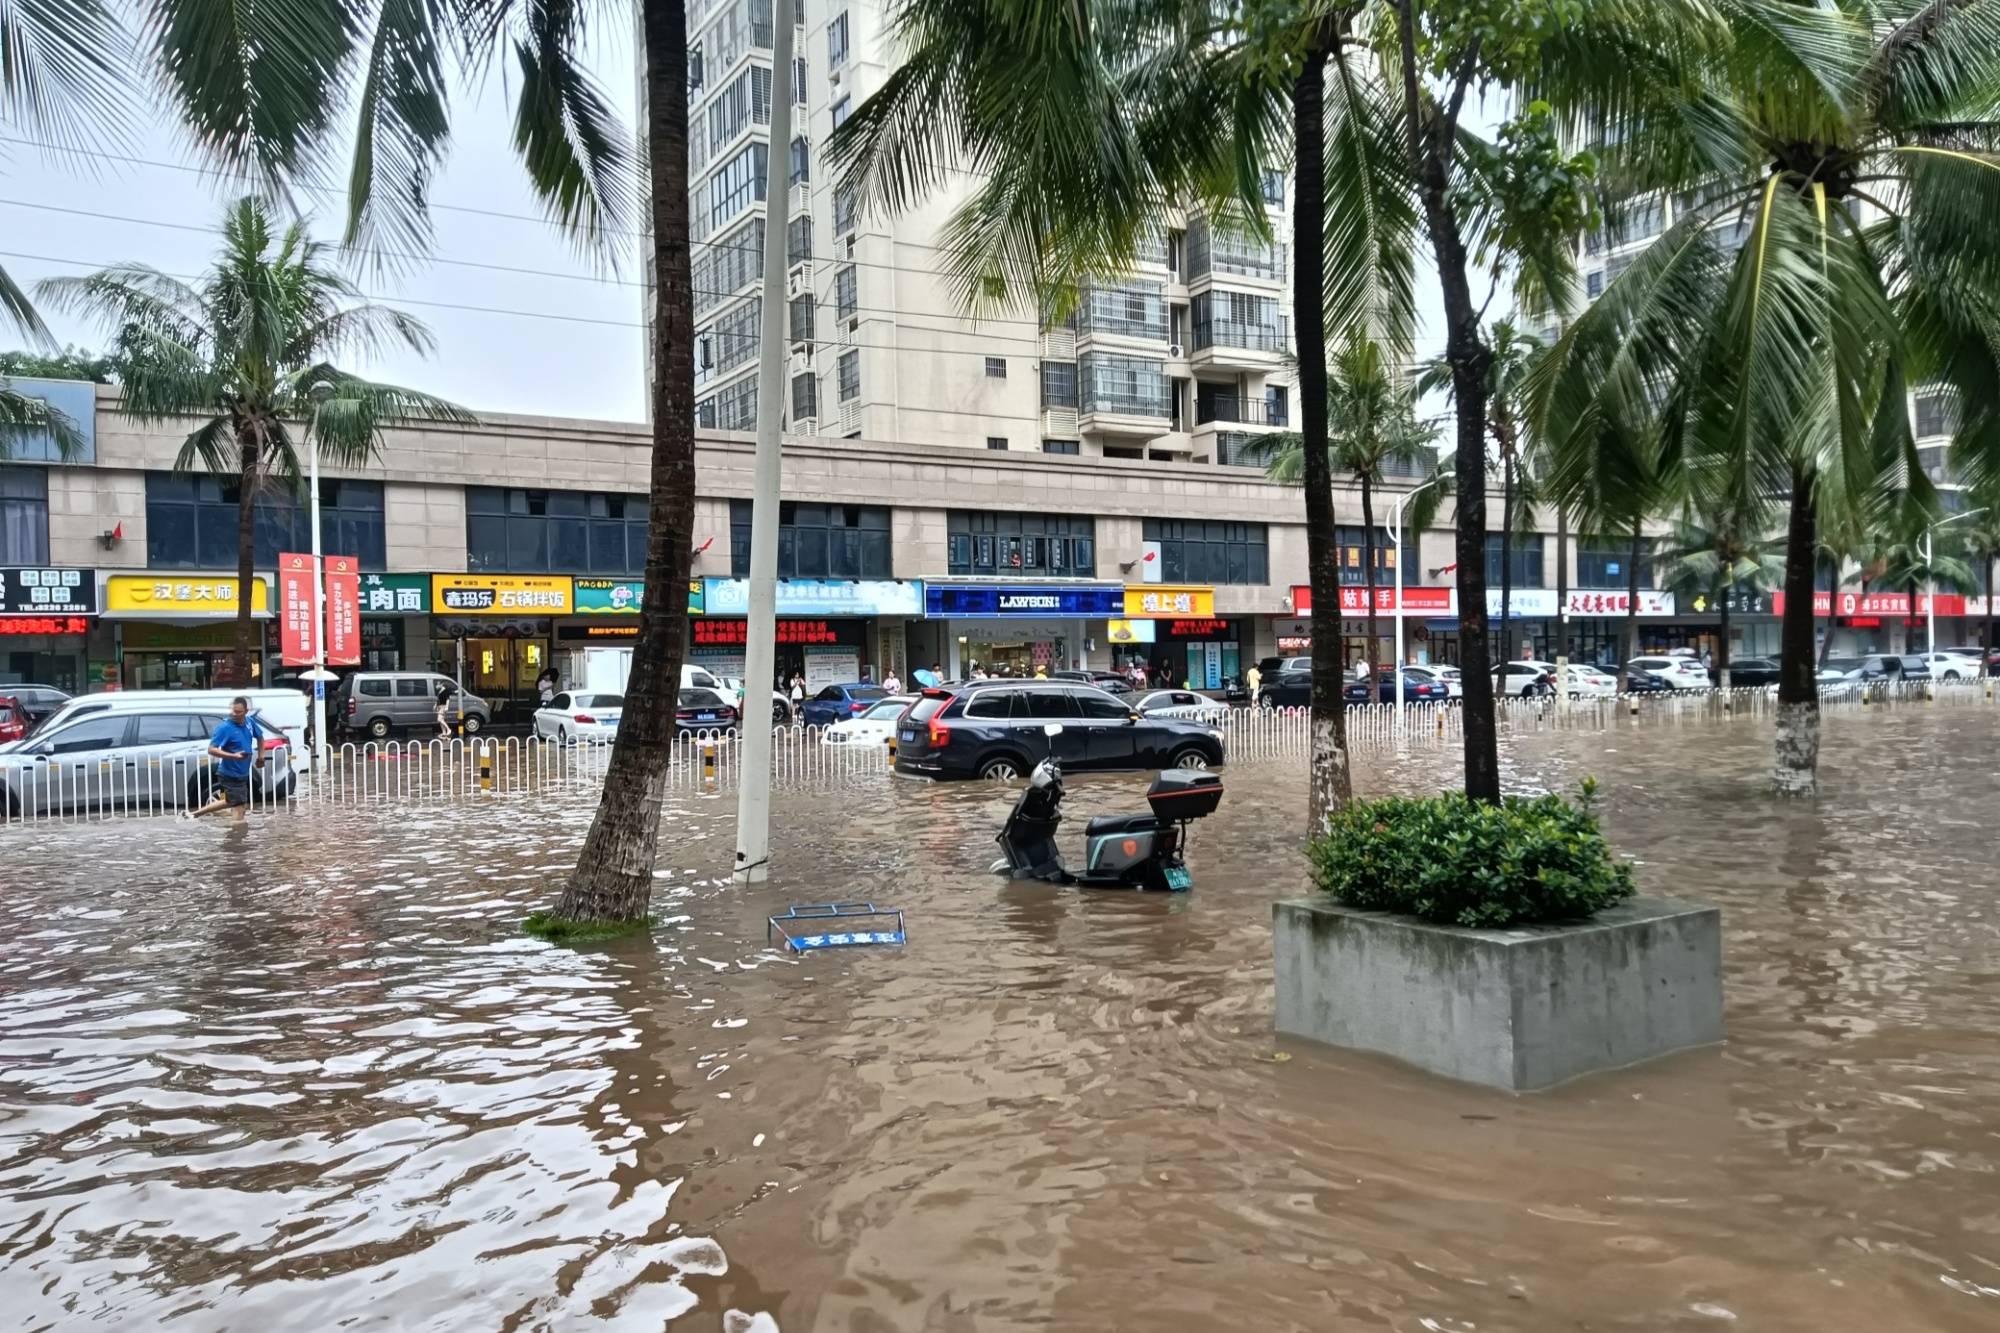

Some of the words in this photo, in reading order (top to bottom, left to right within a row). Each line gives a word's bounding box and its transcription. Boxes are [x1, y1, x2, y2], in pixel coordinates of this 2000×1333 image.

[154, 584, 232, 600] 汉堡大师
[500, 591, 564, 607] 石锅拌饭
[1000, 596, 1054, 608] LAWSON
